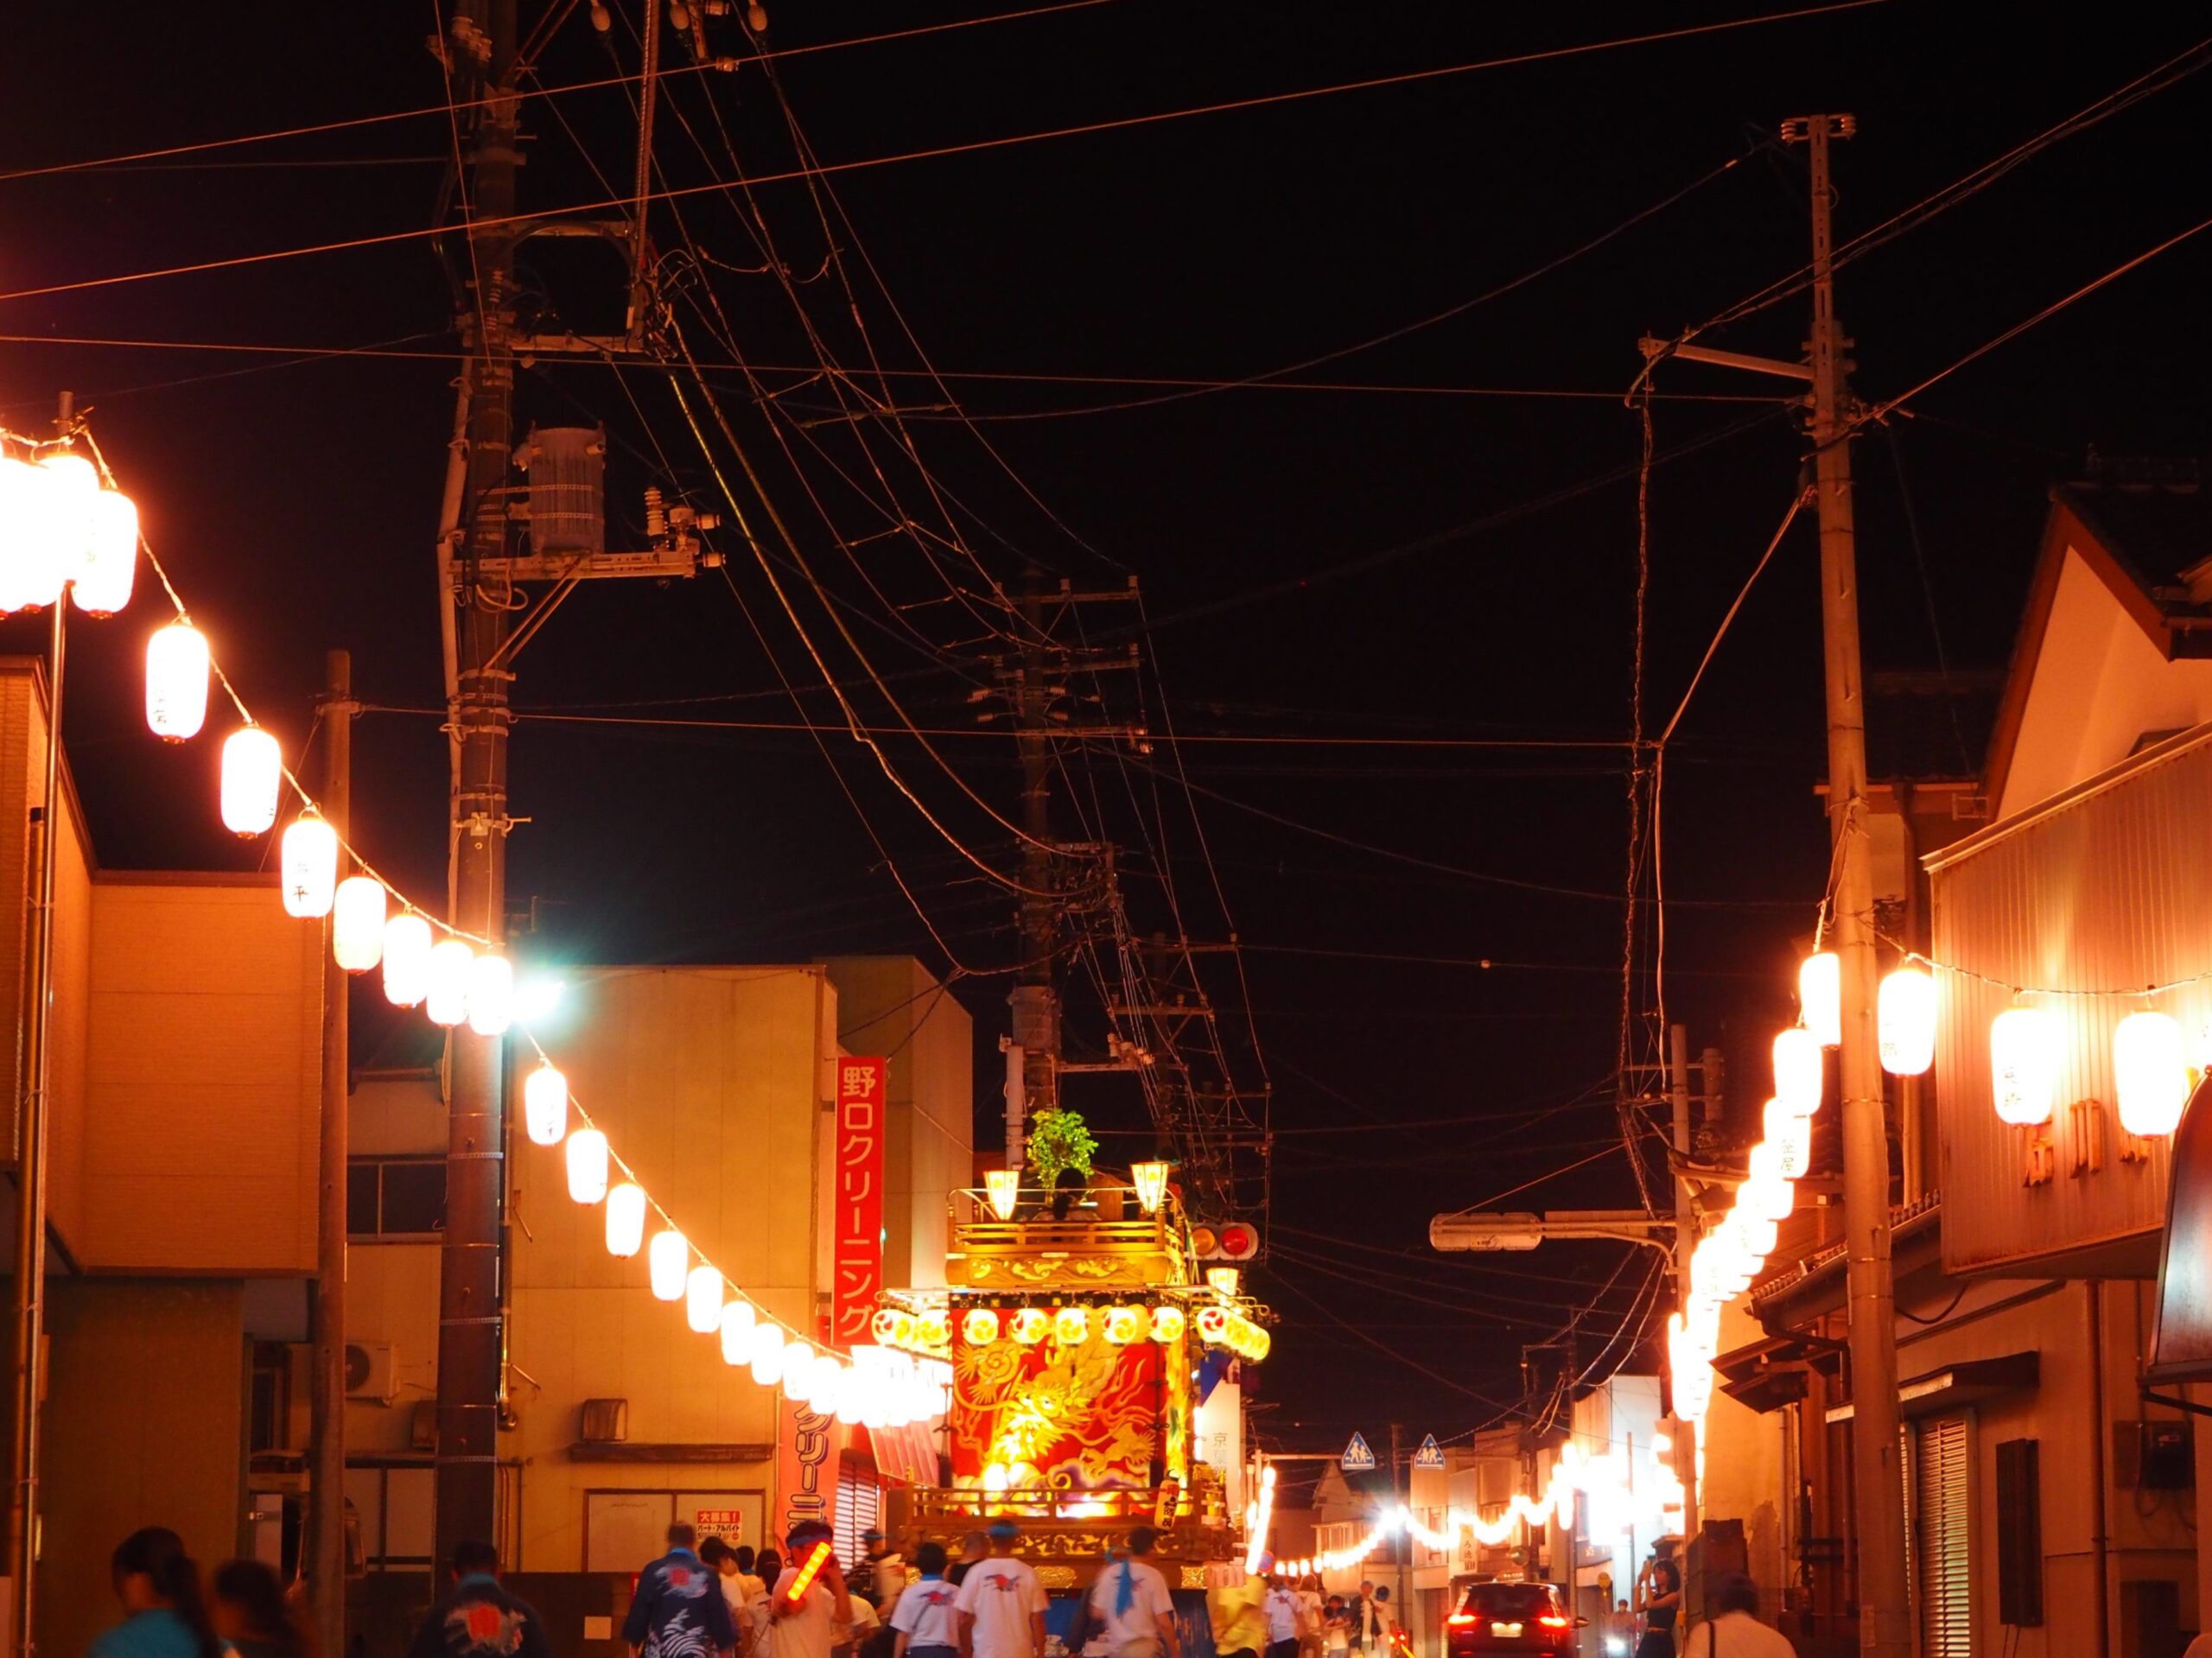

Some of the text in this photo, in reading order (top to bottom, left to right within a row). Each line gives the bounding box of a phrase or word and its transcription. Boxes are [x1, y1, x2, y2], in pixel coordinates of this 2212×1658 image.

[840, 1065, 876, 1337] 野口クリーニング
